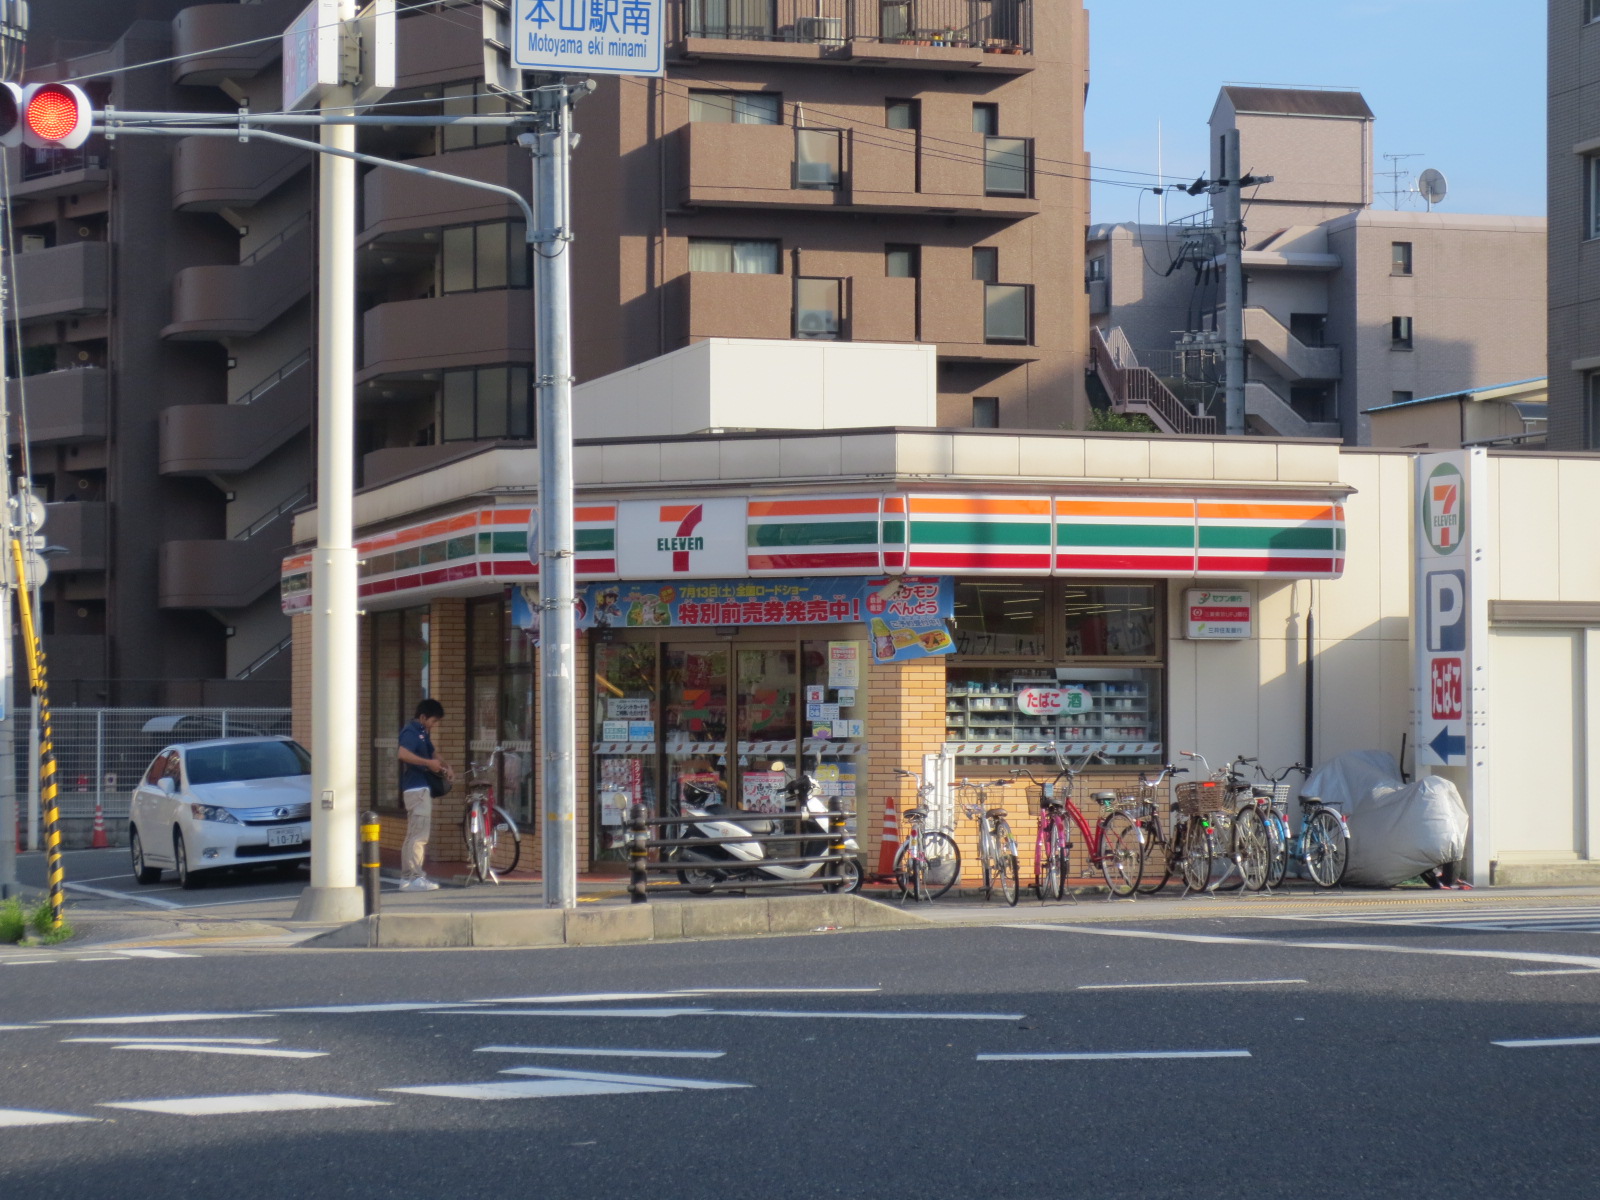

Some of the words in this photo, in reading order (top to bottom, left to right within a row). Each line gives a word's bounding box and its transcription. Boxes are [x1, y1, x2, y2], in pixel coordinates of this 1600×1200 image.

[525, 0, 650, 36] 本山駅南
[528, 32, 583, 57] Motoyama
[588, 36, 604, 55] eki
[608, 39, 647, 58] minami
[659, 504, 703, 572] 7
[888, 601, 939, 615] べんとう
[1431, 573, 1463, 650] P
[1027, 692, 1061, 708] たばこ
[1067, 692, 1082, 708] 酒
[1432, 663, 1462, 714] たばこ
